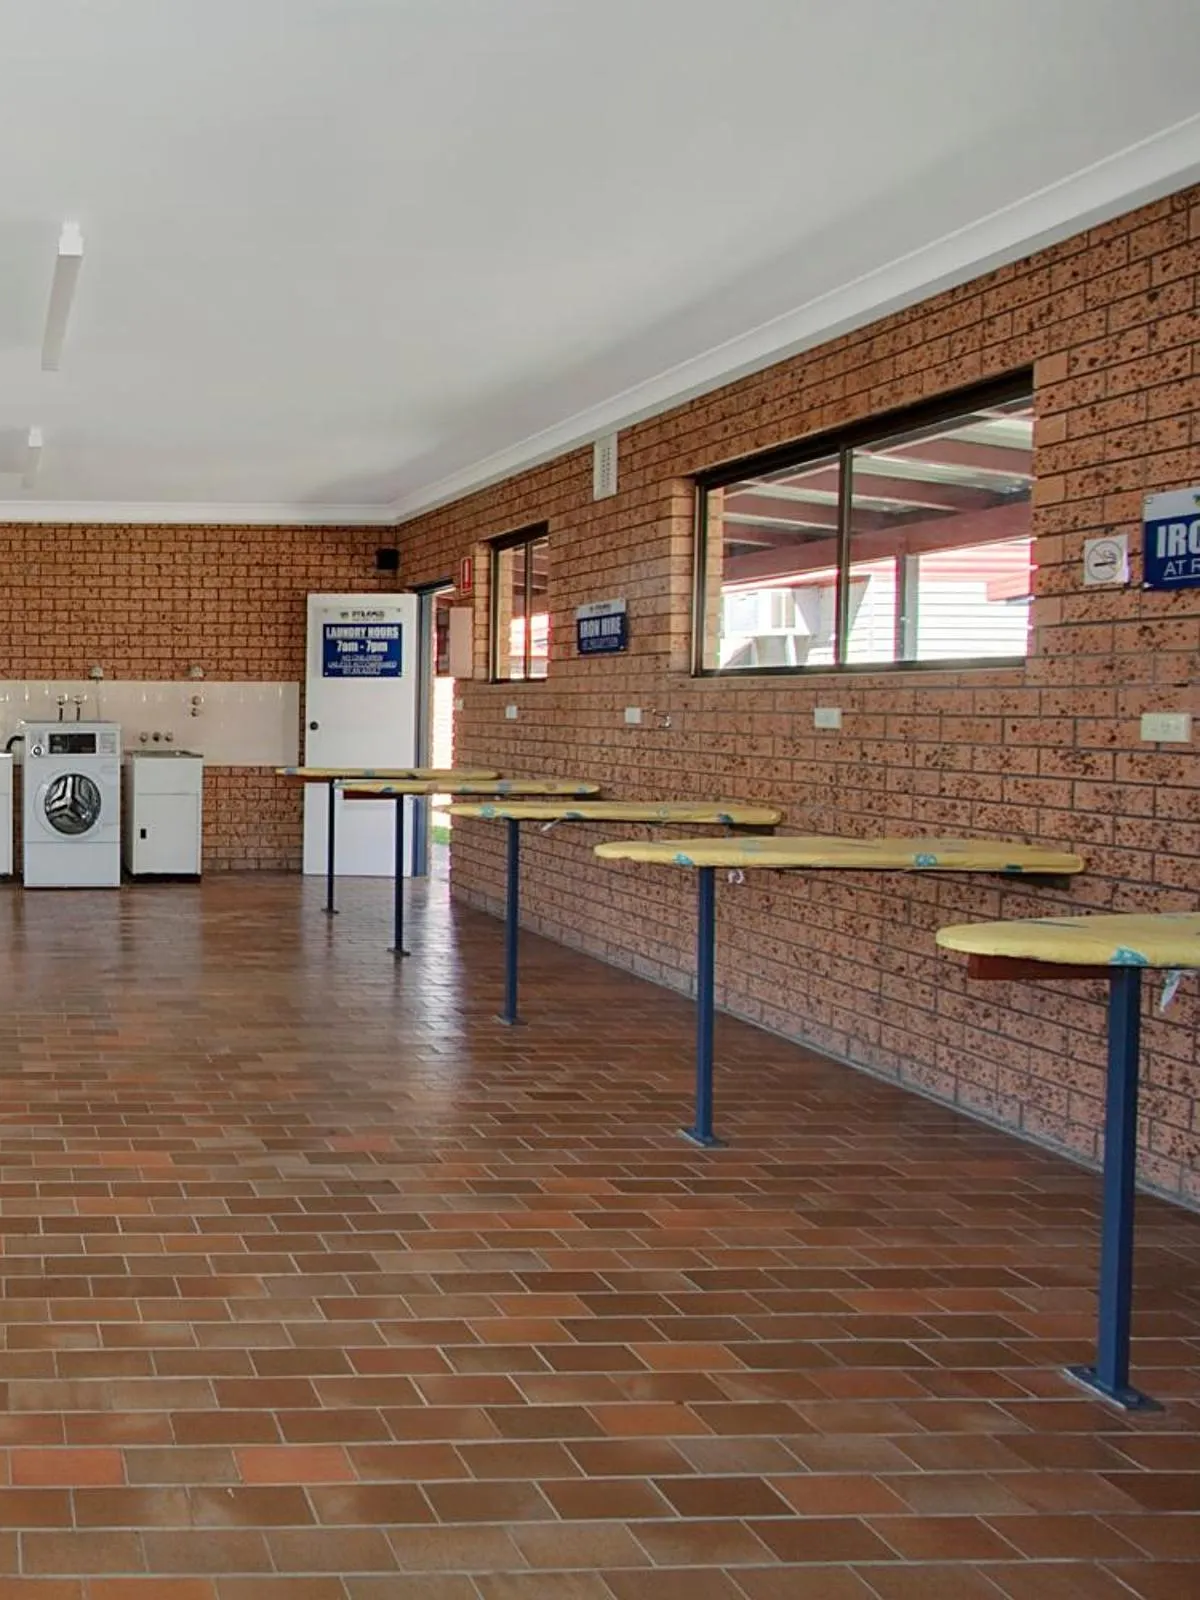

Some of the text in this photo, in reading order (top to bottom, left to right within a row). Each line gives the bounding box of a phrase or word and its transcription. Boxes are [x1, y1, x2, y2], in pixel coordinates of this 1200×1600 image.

[1164, 559, 1187, 577] AT
[325, 626, 399, 639] LAUNDRY HOURS
[336, 640, 359, 653] 7am
[366, 640, 388, 653] 7pm
